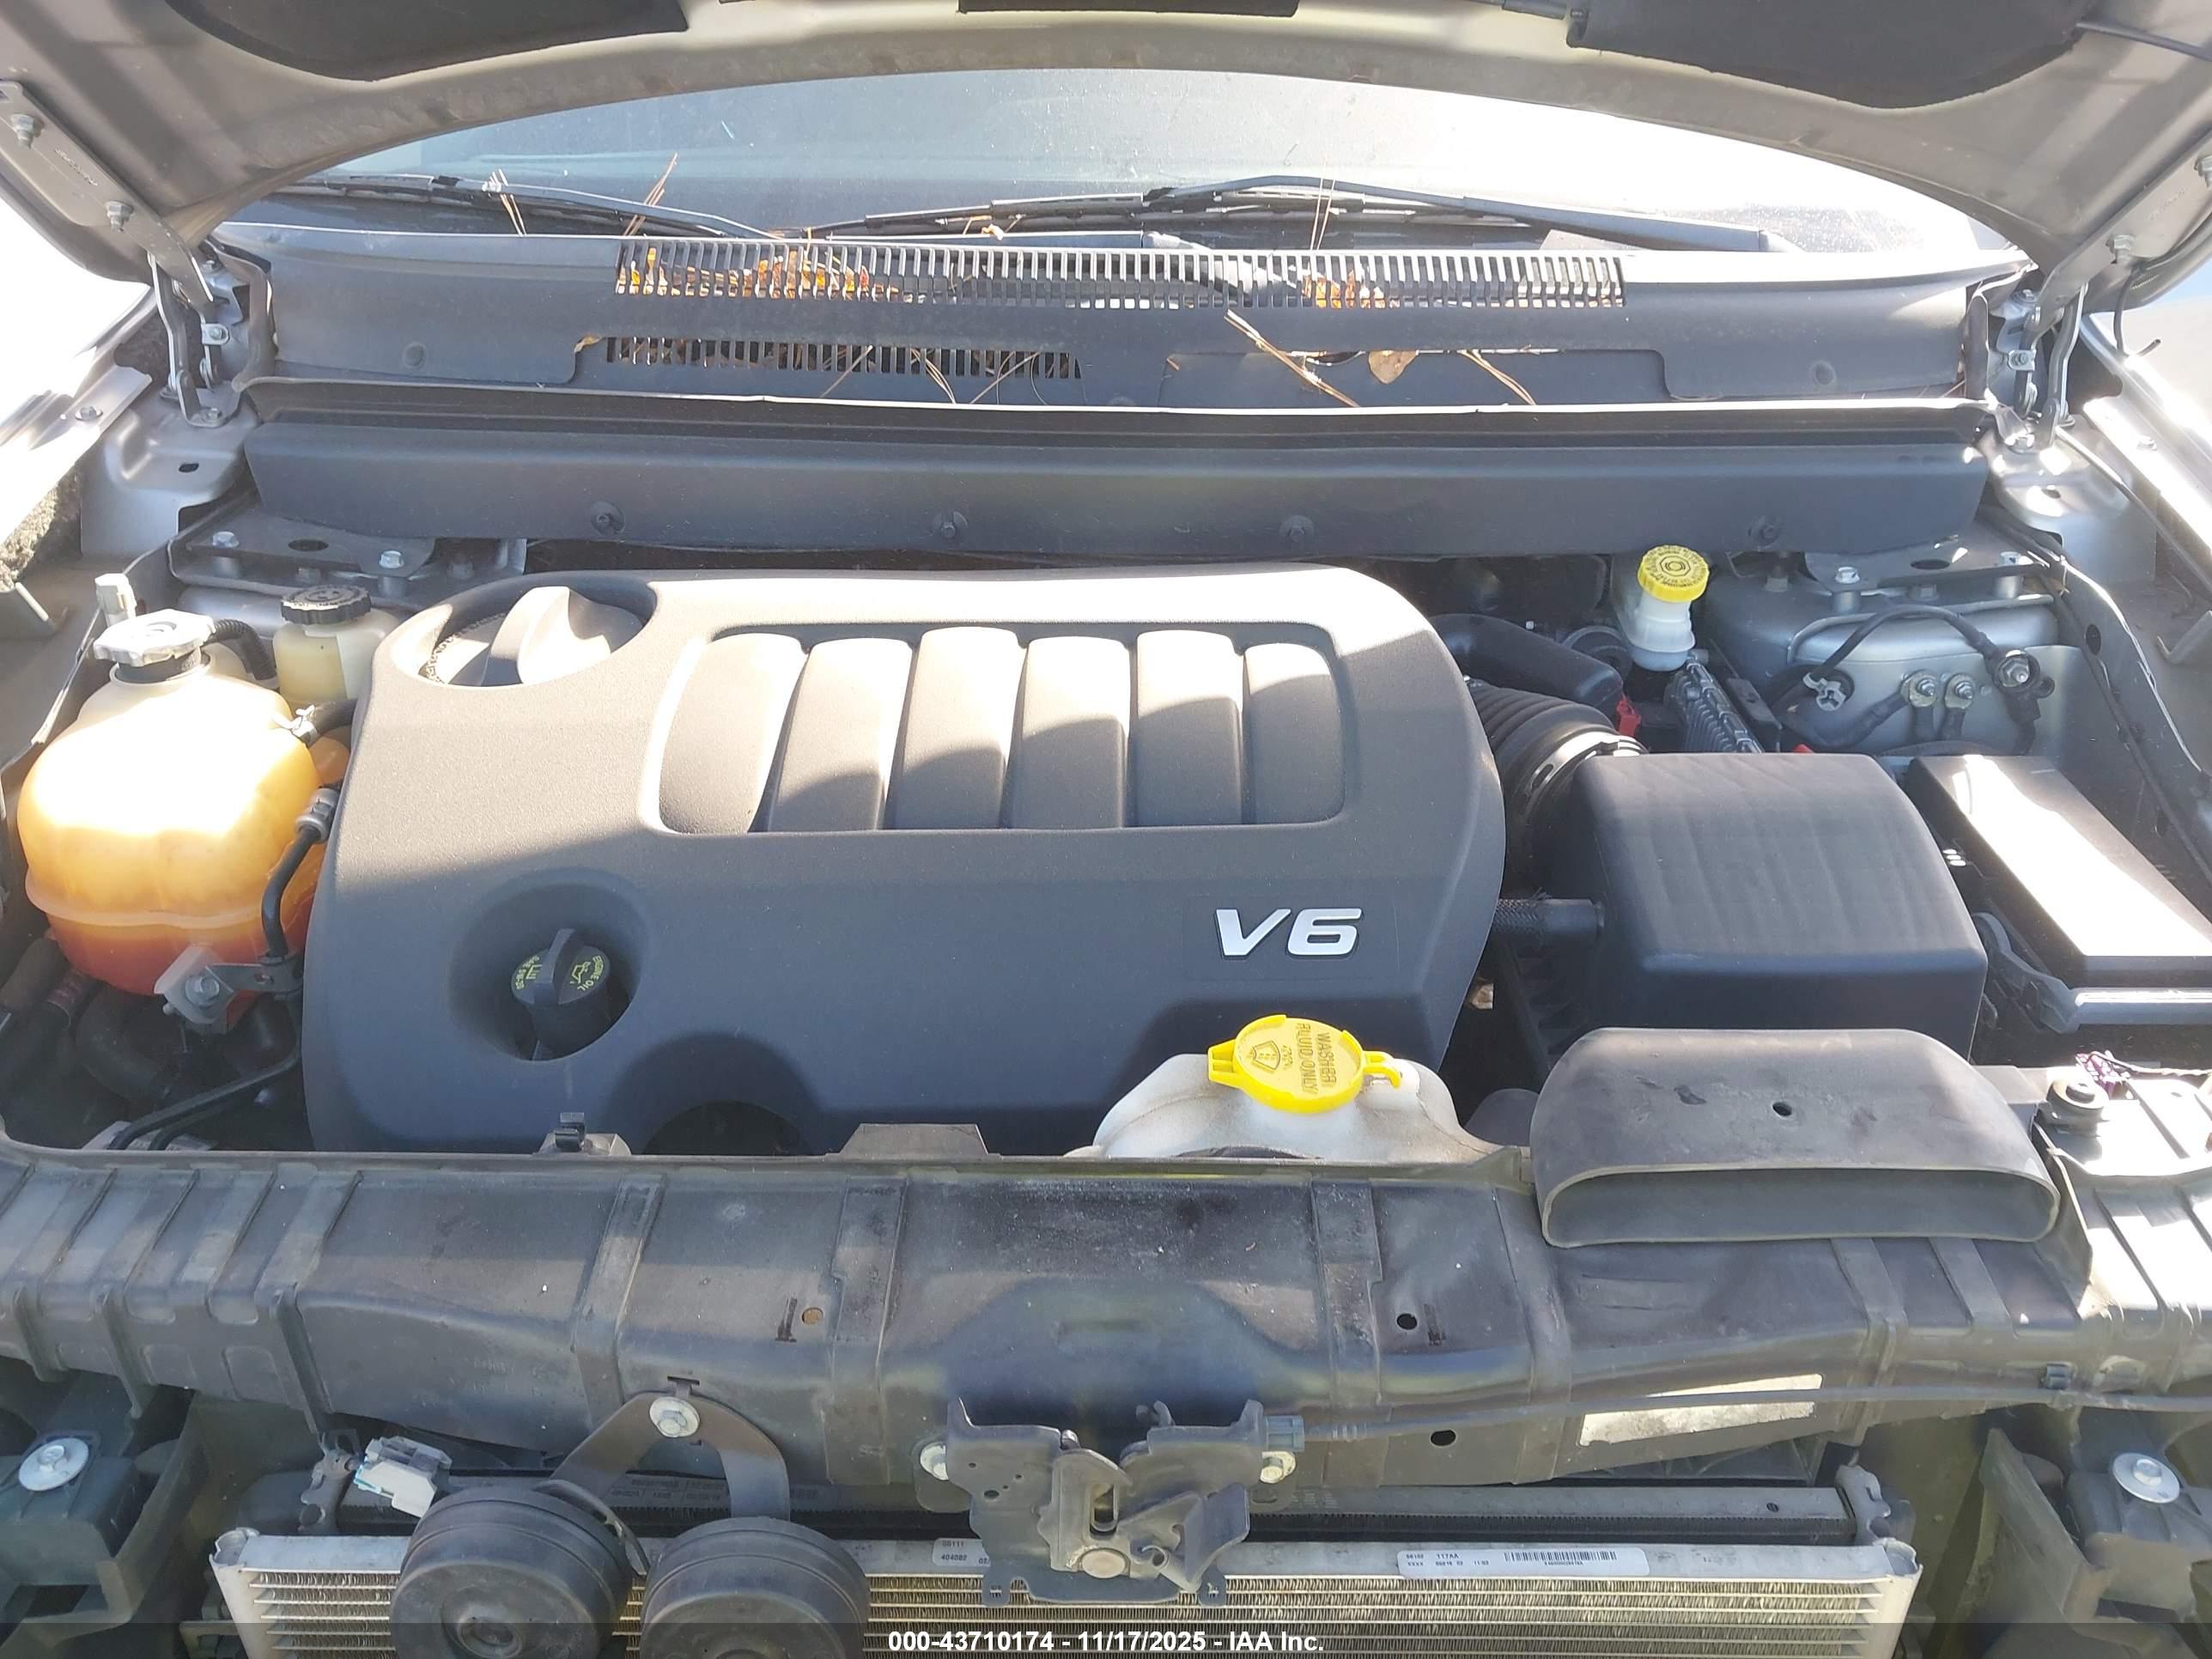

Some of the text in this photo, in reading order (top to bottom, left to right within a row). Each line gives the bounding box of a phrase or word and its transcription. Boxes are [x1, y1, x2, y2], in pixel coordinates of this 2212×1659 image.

[1216, 908, 1362, 957] V6
[576, 980, 594, 992] OIL
[1297, 1023, 1320, 1095] FLUID ONLY
[1316, 1031, 1338, 1089] WASHER
